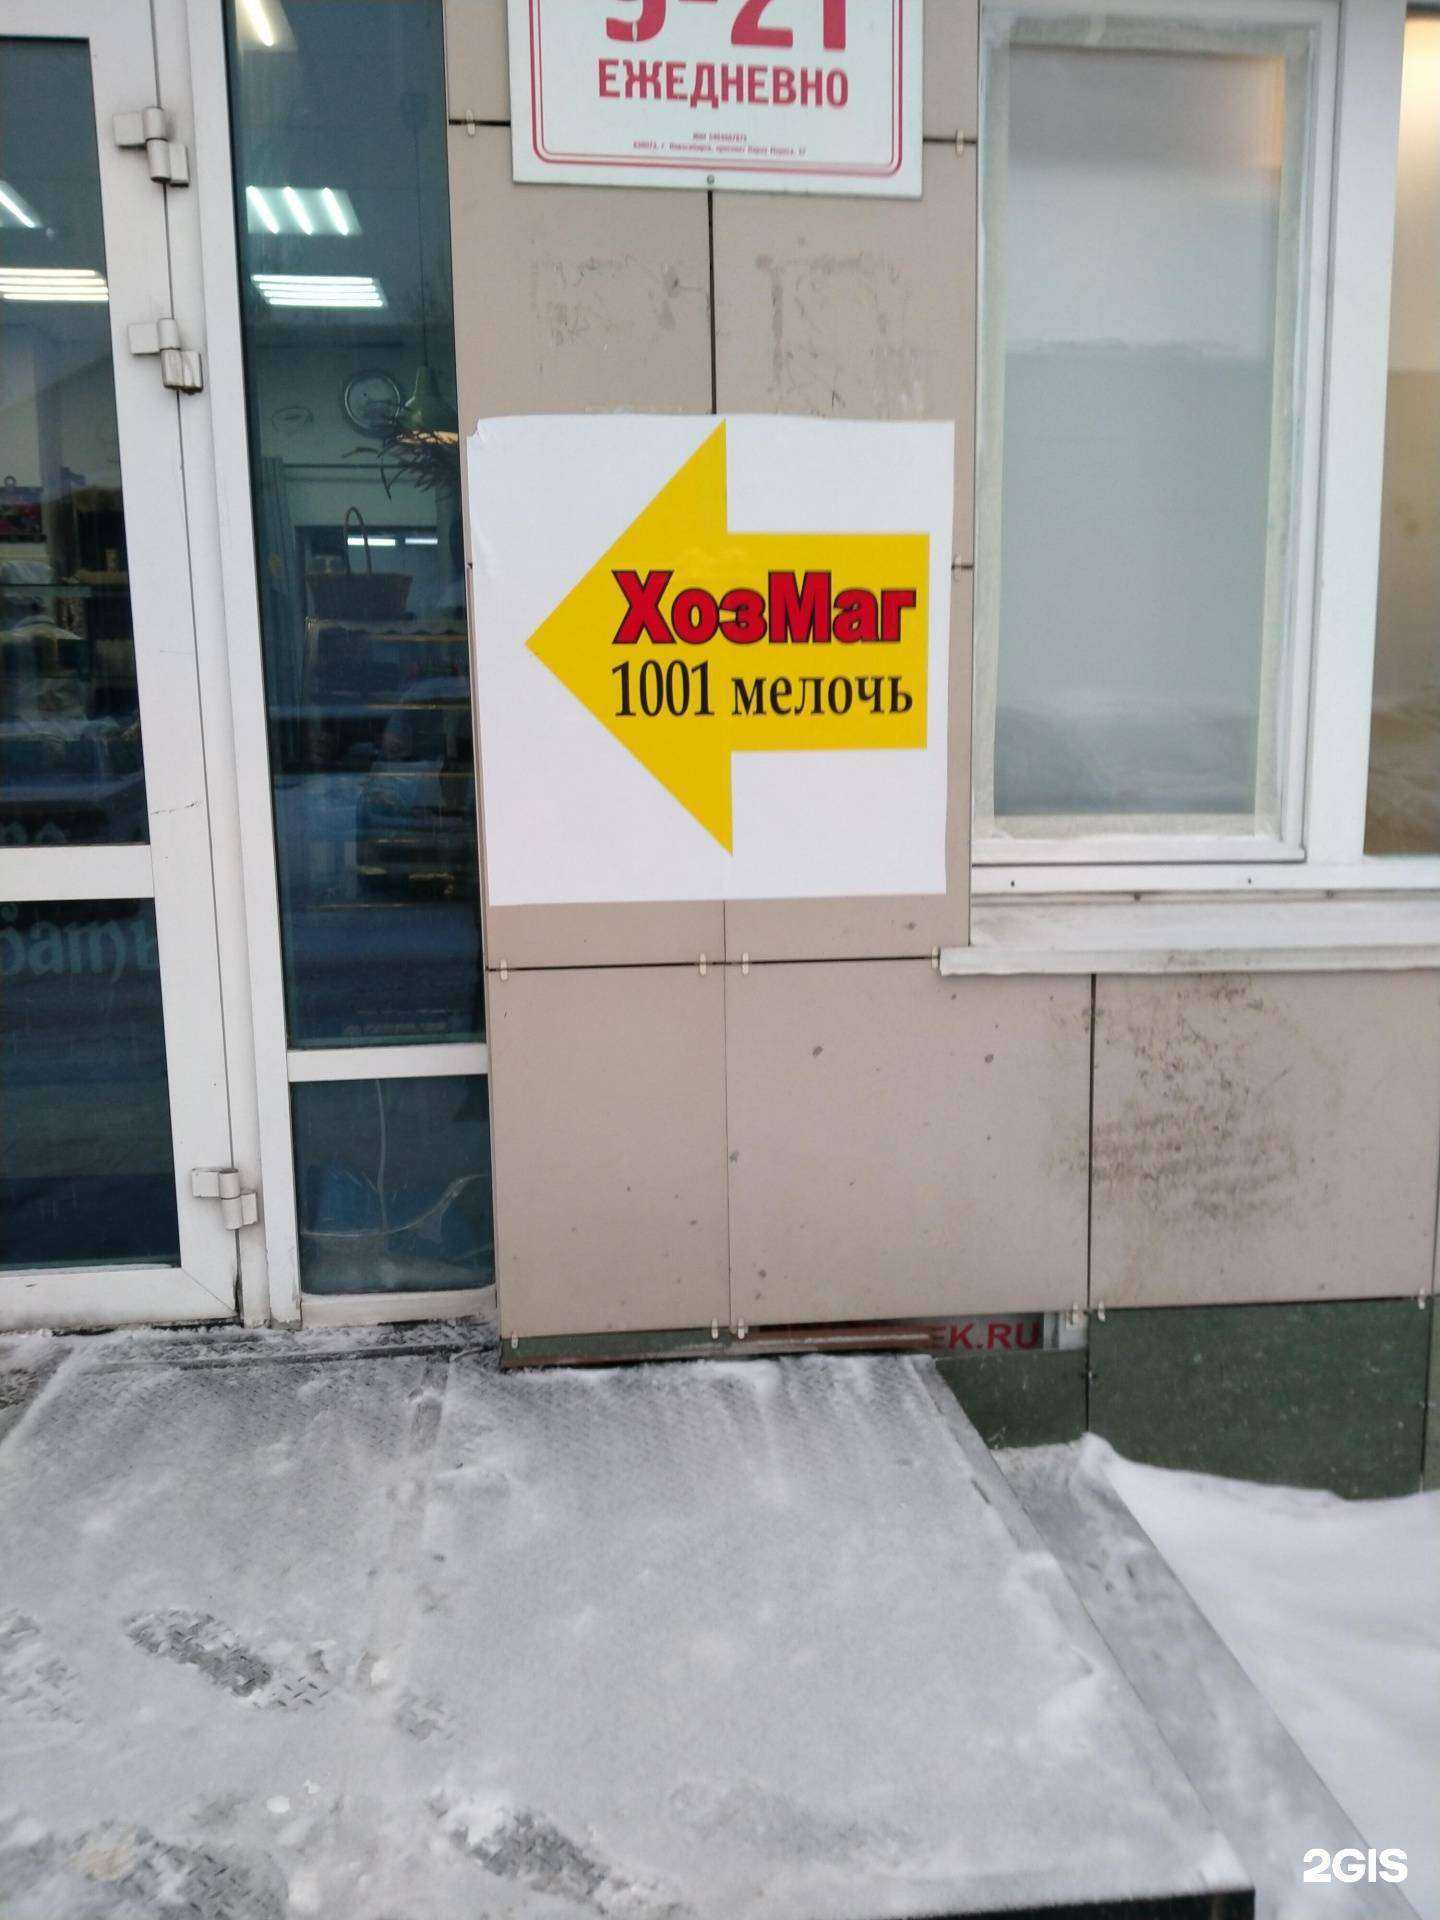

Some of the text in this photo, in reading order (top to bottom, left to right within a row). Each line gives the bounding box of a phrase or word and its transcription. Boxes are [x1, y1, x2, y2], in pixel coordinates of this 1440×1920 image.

[598, 58, 848, 109] ЕЖЕДНЕВНО
[611, 569, 917, 645] ХозМаг
[611, 659, 914, 717] 1001 мелочь
